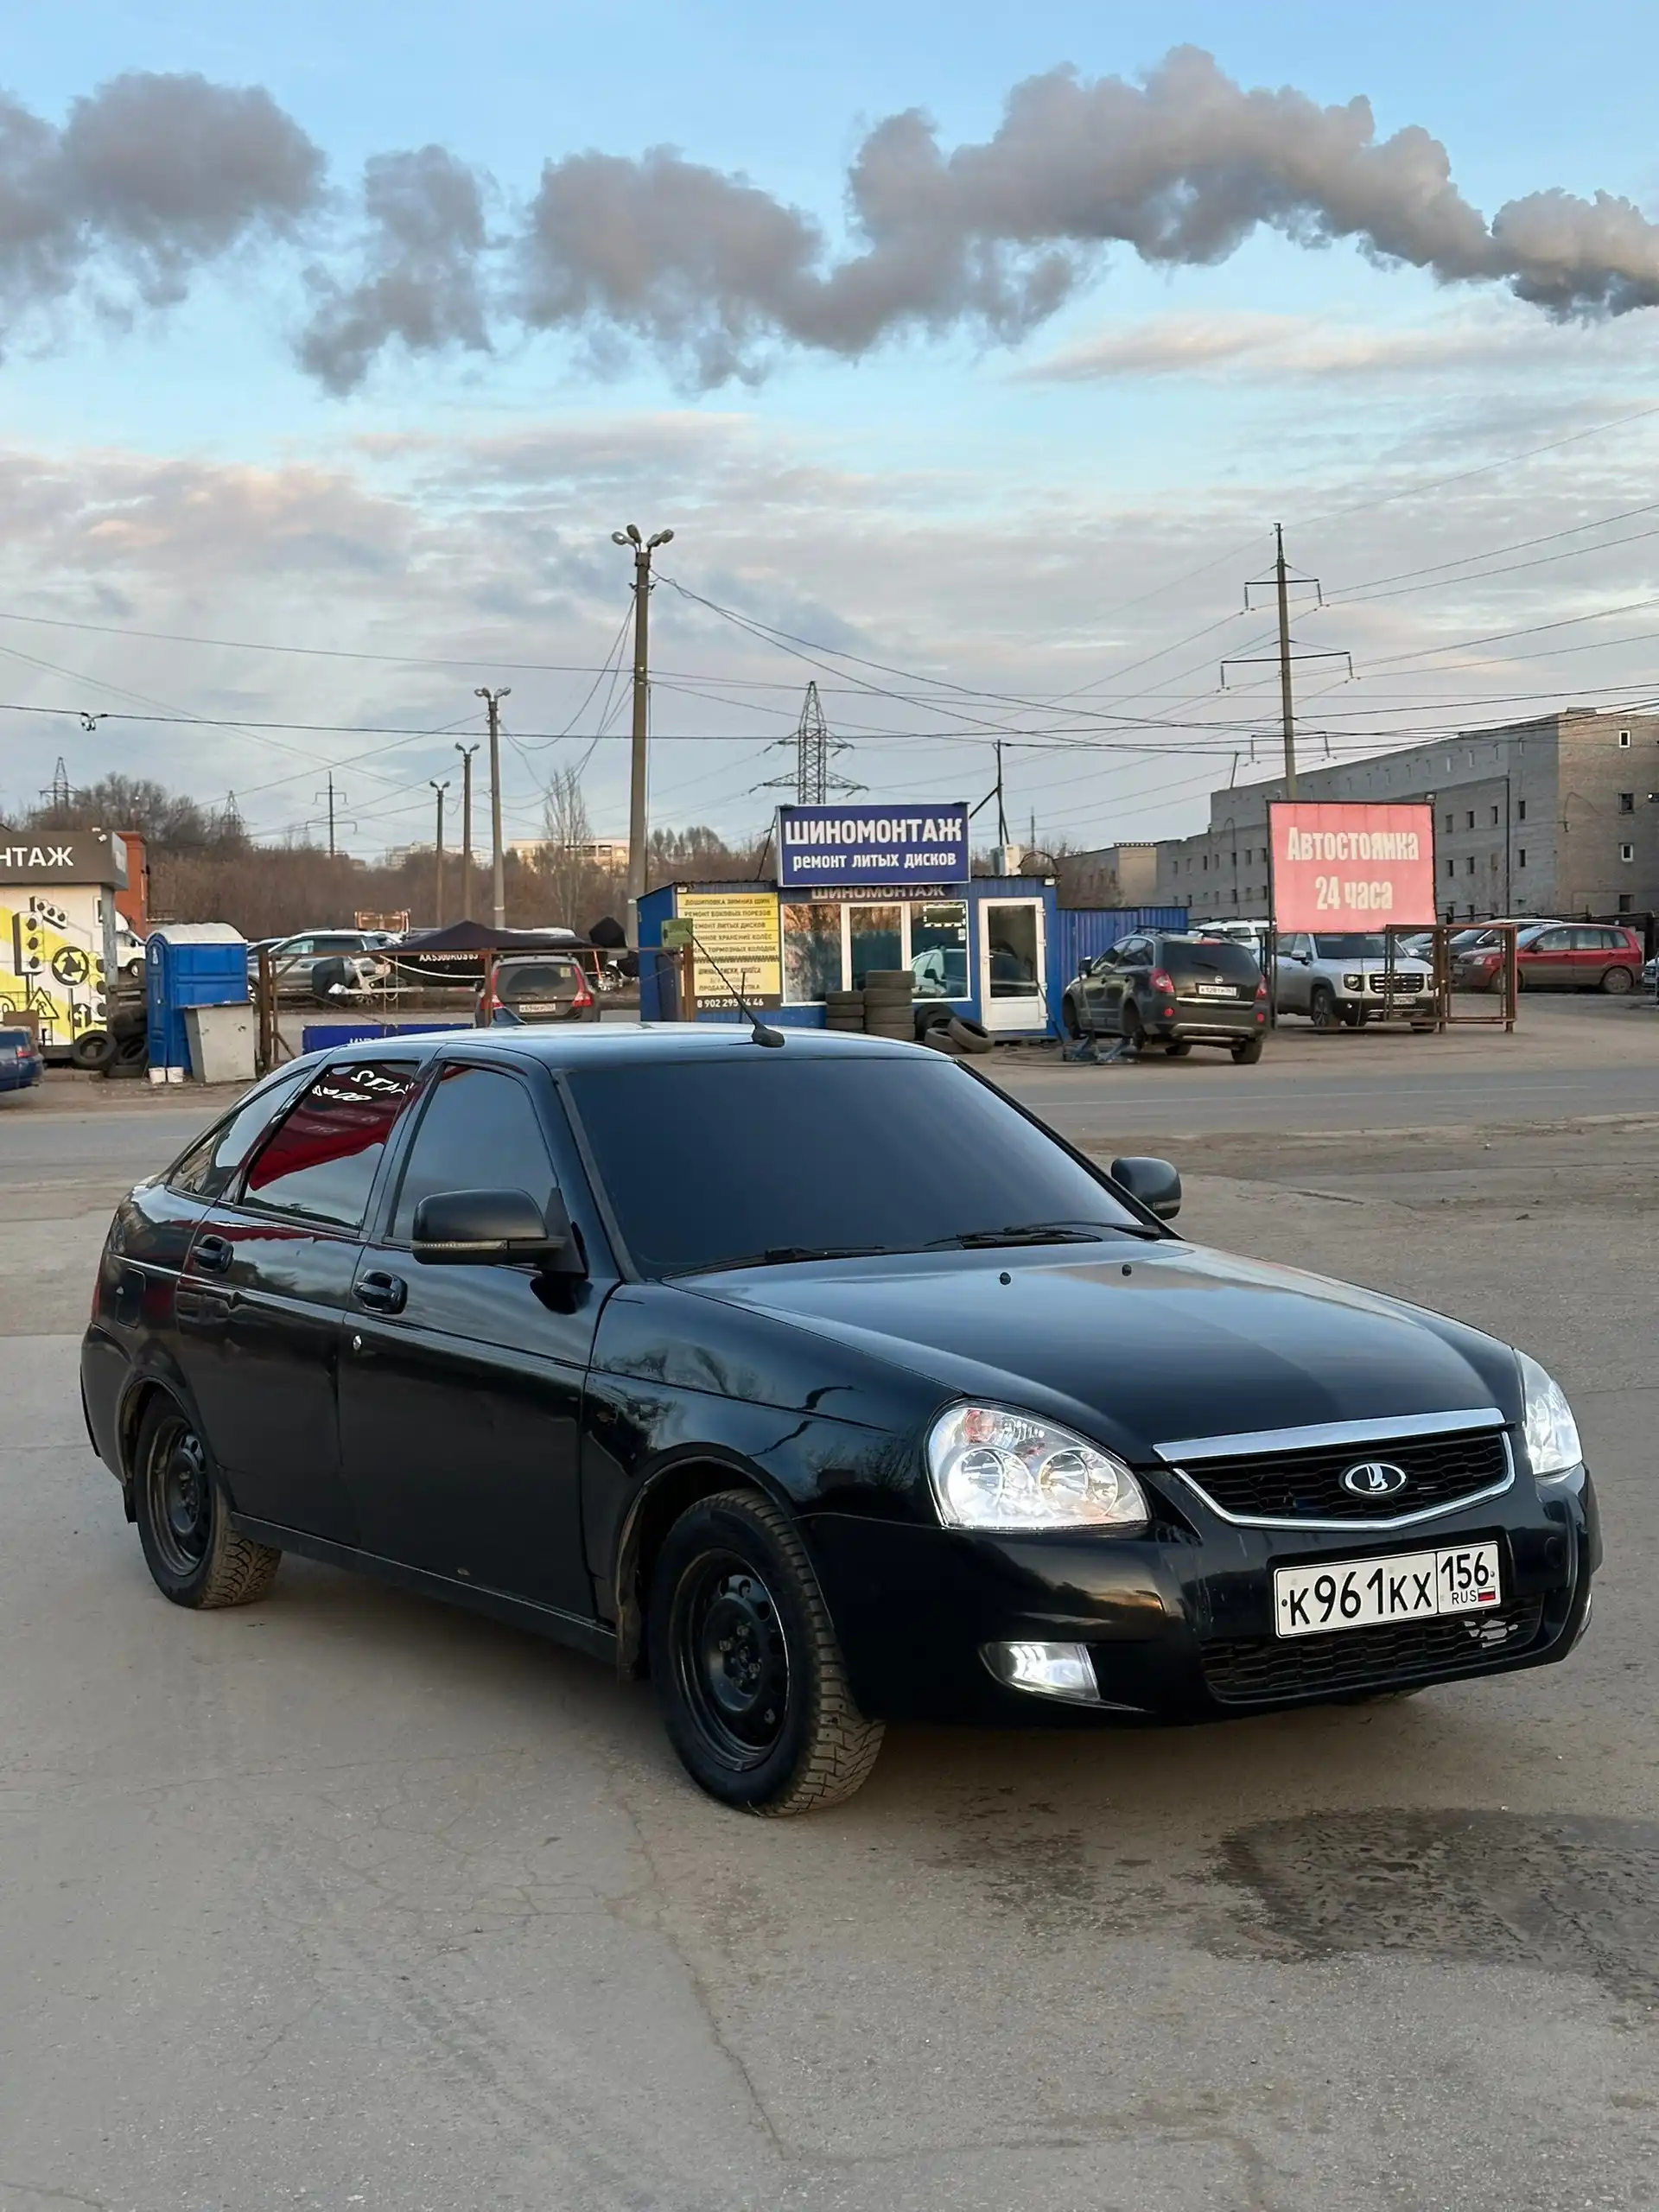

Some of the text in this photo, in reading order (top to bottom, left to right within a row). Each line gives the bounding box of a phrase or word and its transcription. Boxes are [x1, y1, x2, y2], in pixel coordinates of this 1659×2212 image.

[785, 818, 962, 845] ШИНОМОНТАЖ
[1287, 827, 1419, 861] Автостоянка
[793, 853, 957, 871] ремонт литых дисков
[811, 886, 945, 899] ШИНОМОНТАЖ
[1315, 875, 1393, 910] 24 часа
[696, 999, 702, 1008] 8
[704, 999, 721, 1007] 902
[721, 998, 739, 1007] 295
[1289, 1552, 1490, 1626] К961КХ 156
[1452, 1590, 1477, 1605] RUS
